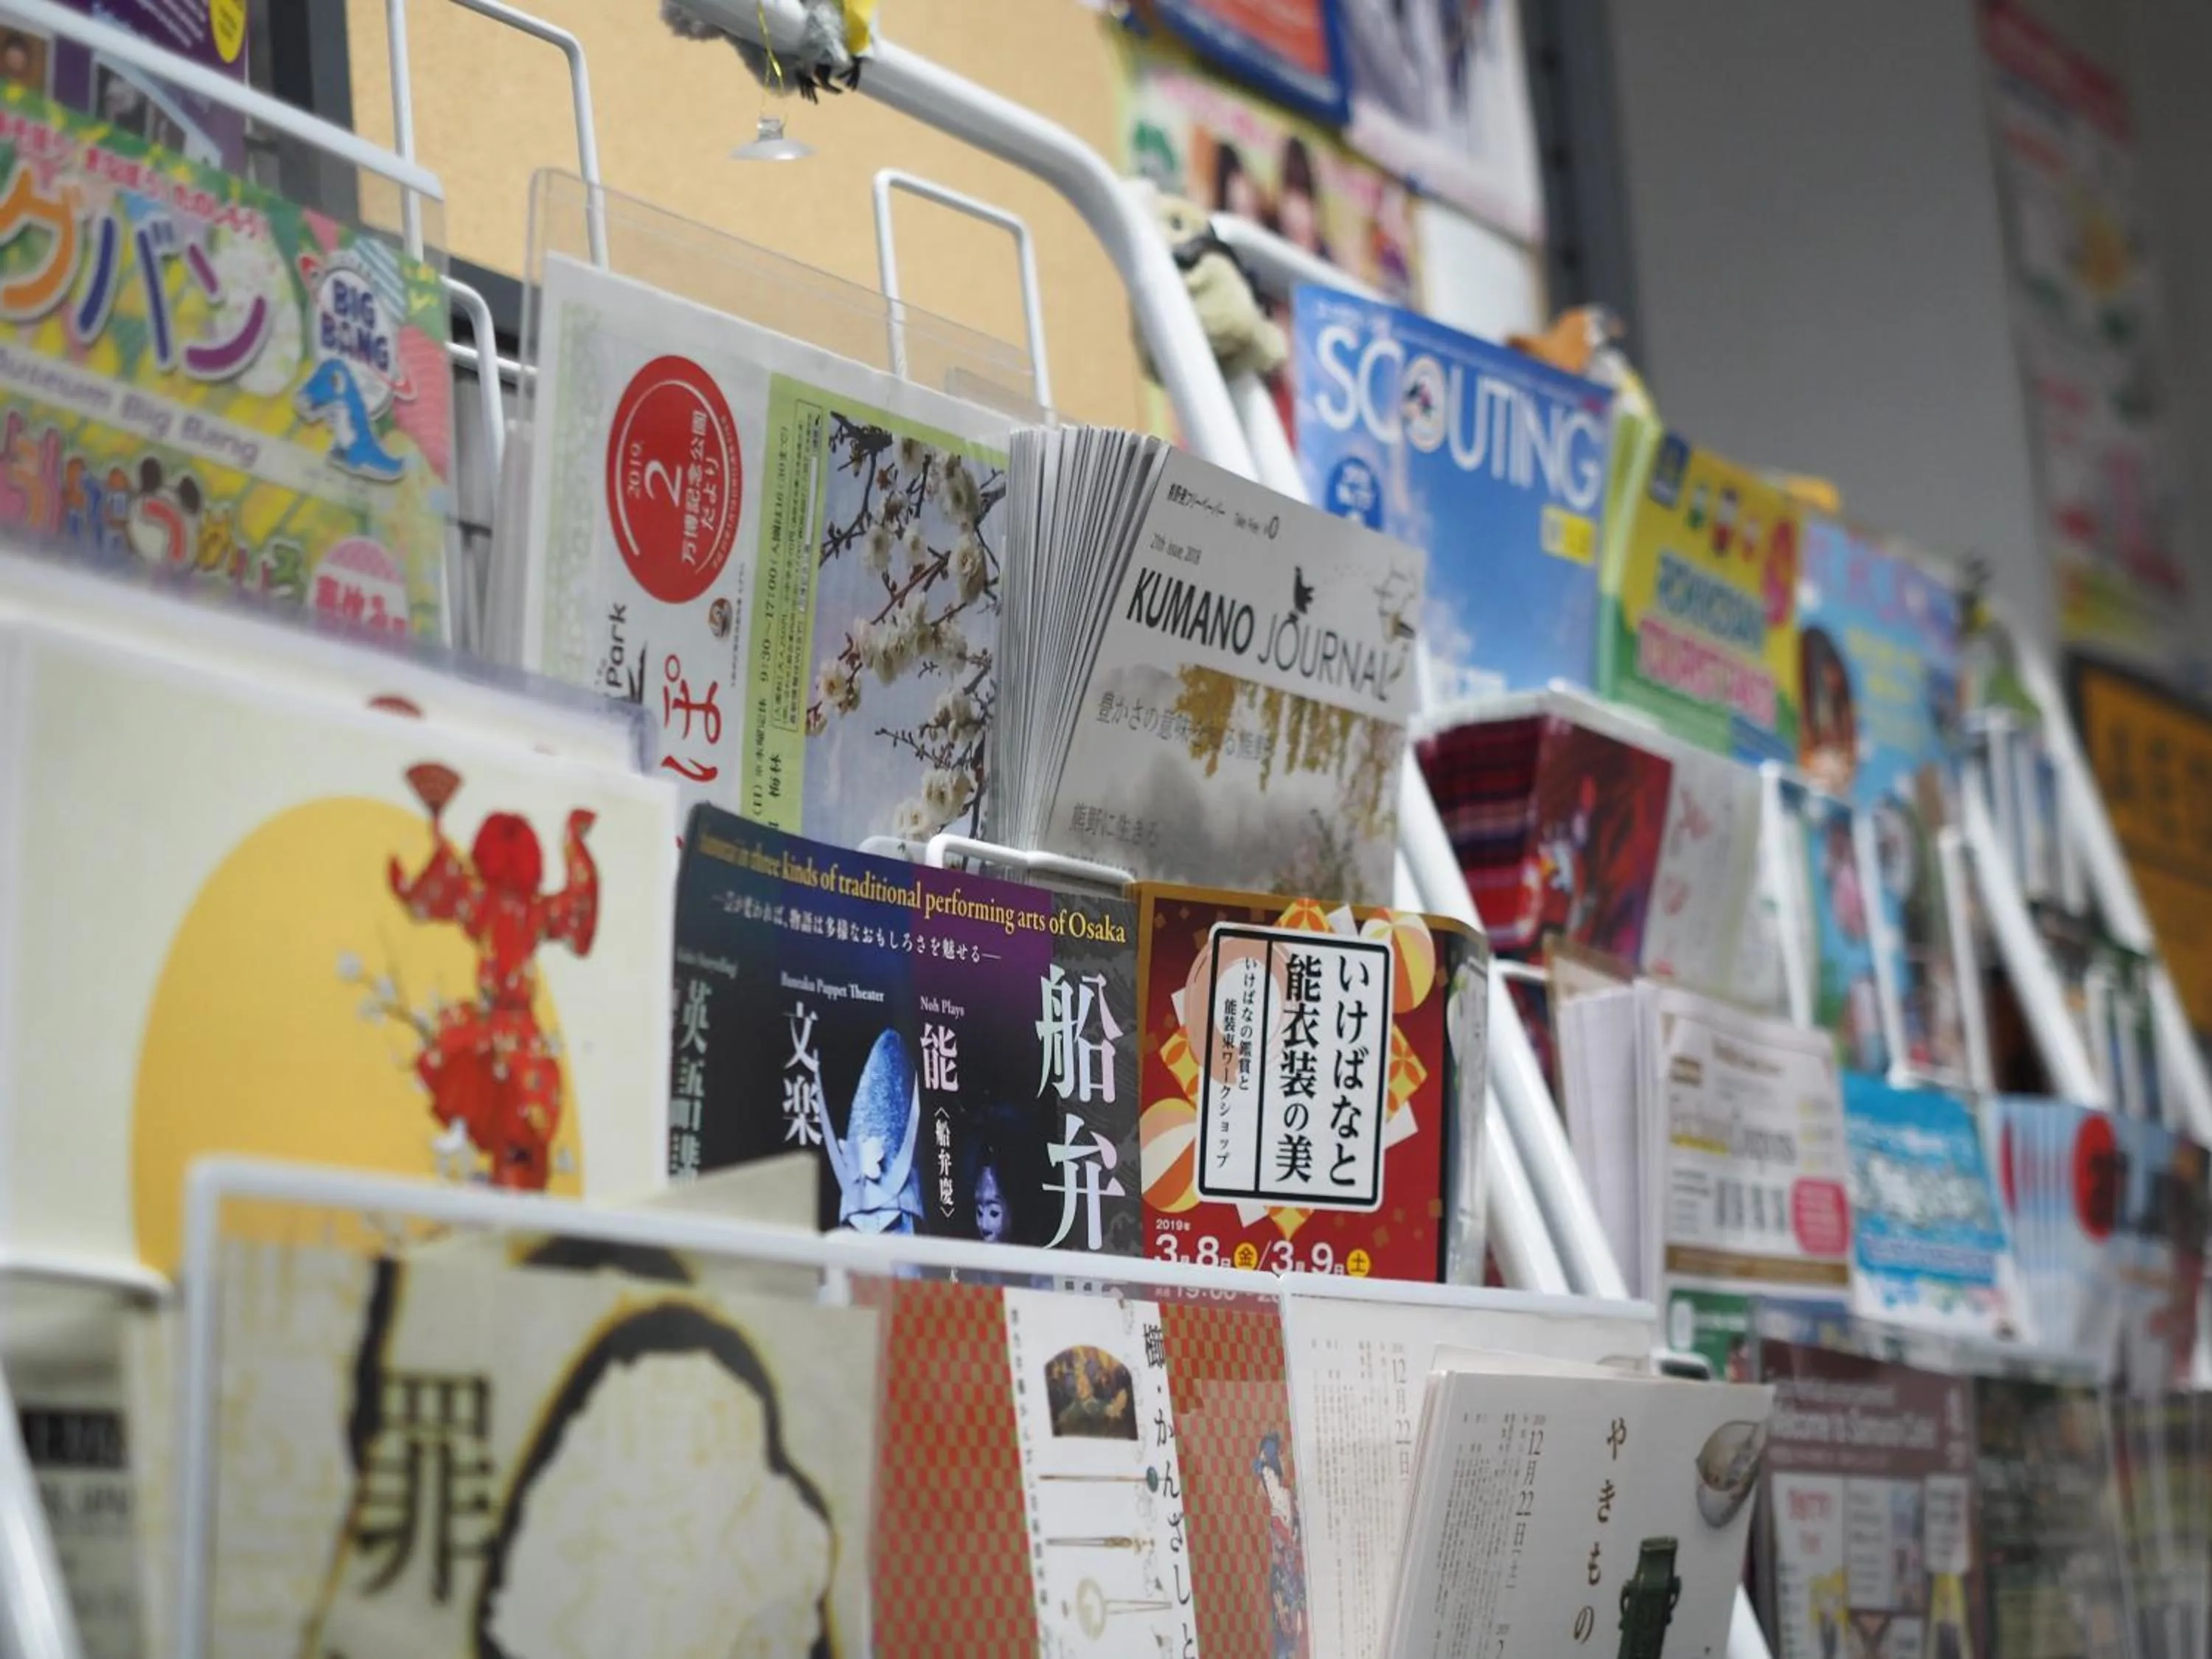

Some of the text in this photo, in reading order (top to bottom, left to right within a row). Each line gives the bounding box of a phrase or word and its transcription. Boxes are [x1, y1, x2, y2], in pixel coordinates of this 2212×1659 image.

[644, 460, 682, 507] 2
[1314, 324, 1601, 510] SCOUTING
[682, 411, 707, 566] 万博記念公園
[605, 602, 627, 689] Park
[1127, 567, 1392, 702] KUMANO JOURNAL
[782, 850, 818, 887] kinds
[820, 863, 839, 891] of
[839, 871, 922, 909] traditional
[925, 888, 1015, 935] performing
[1017, 911, 1046, 932] arts
[1049, 908, 1067, 935] of
[1069, 911, 1126, 943] Osaka
[816, 978, 847, 1000] Puppet
[849, 984, 885, 1003] Theater
[920, 996, 965, 1019] Noh Plays
[920, 1023, 959, 1092] 能
[1238, 958, 1257, 1091] いけばなの鑑賞と
[782, 1001, 823, 1146] 文楽
[1035, 964, 1126, 1251] 船弁
[1217, 998, 1237, 1168] 能装束ワークショップ
[1276, 953, 1322, 1183] 能衣装の美
[1327, 955, 1371, 1186] いけばなと
[1155, 1219, 1191, 1231] 2019年
[1573, 1416, 1627, 1645] やきもの
